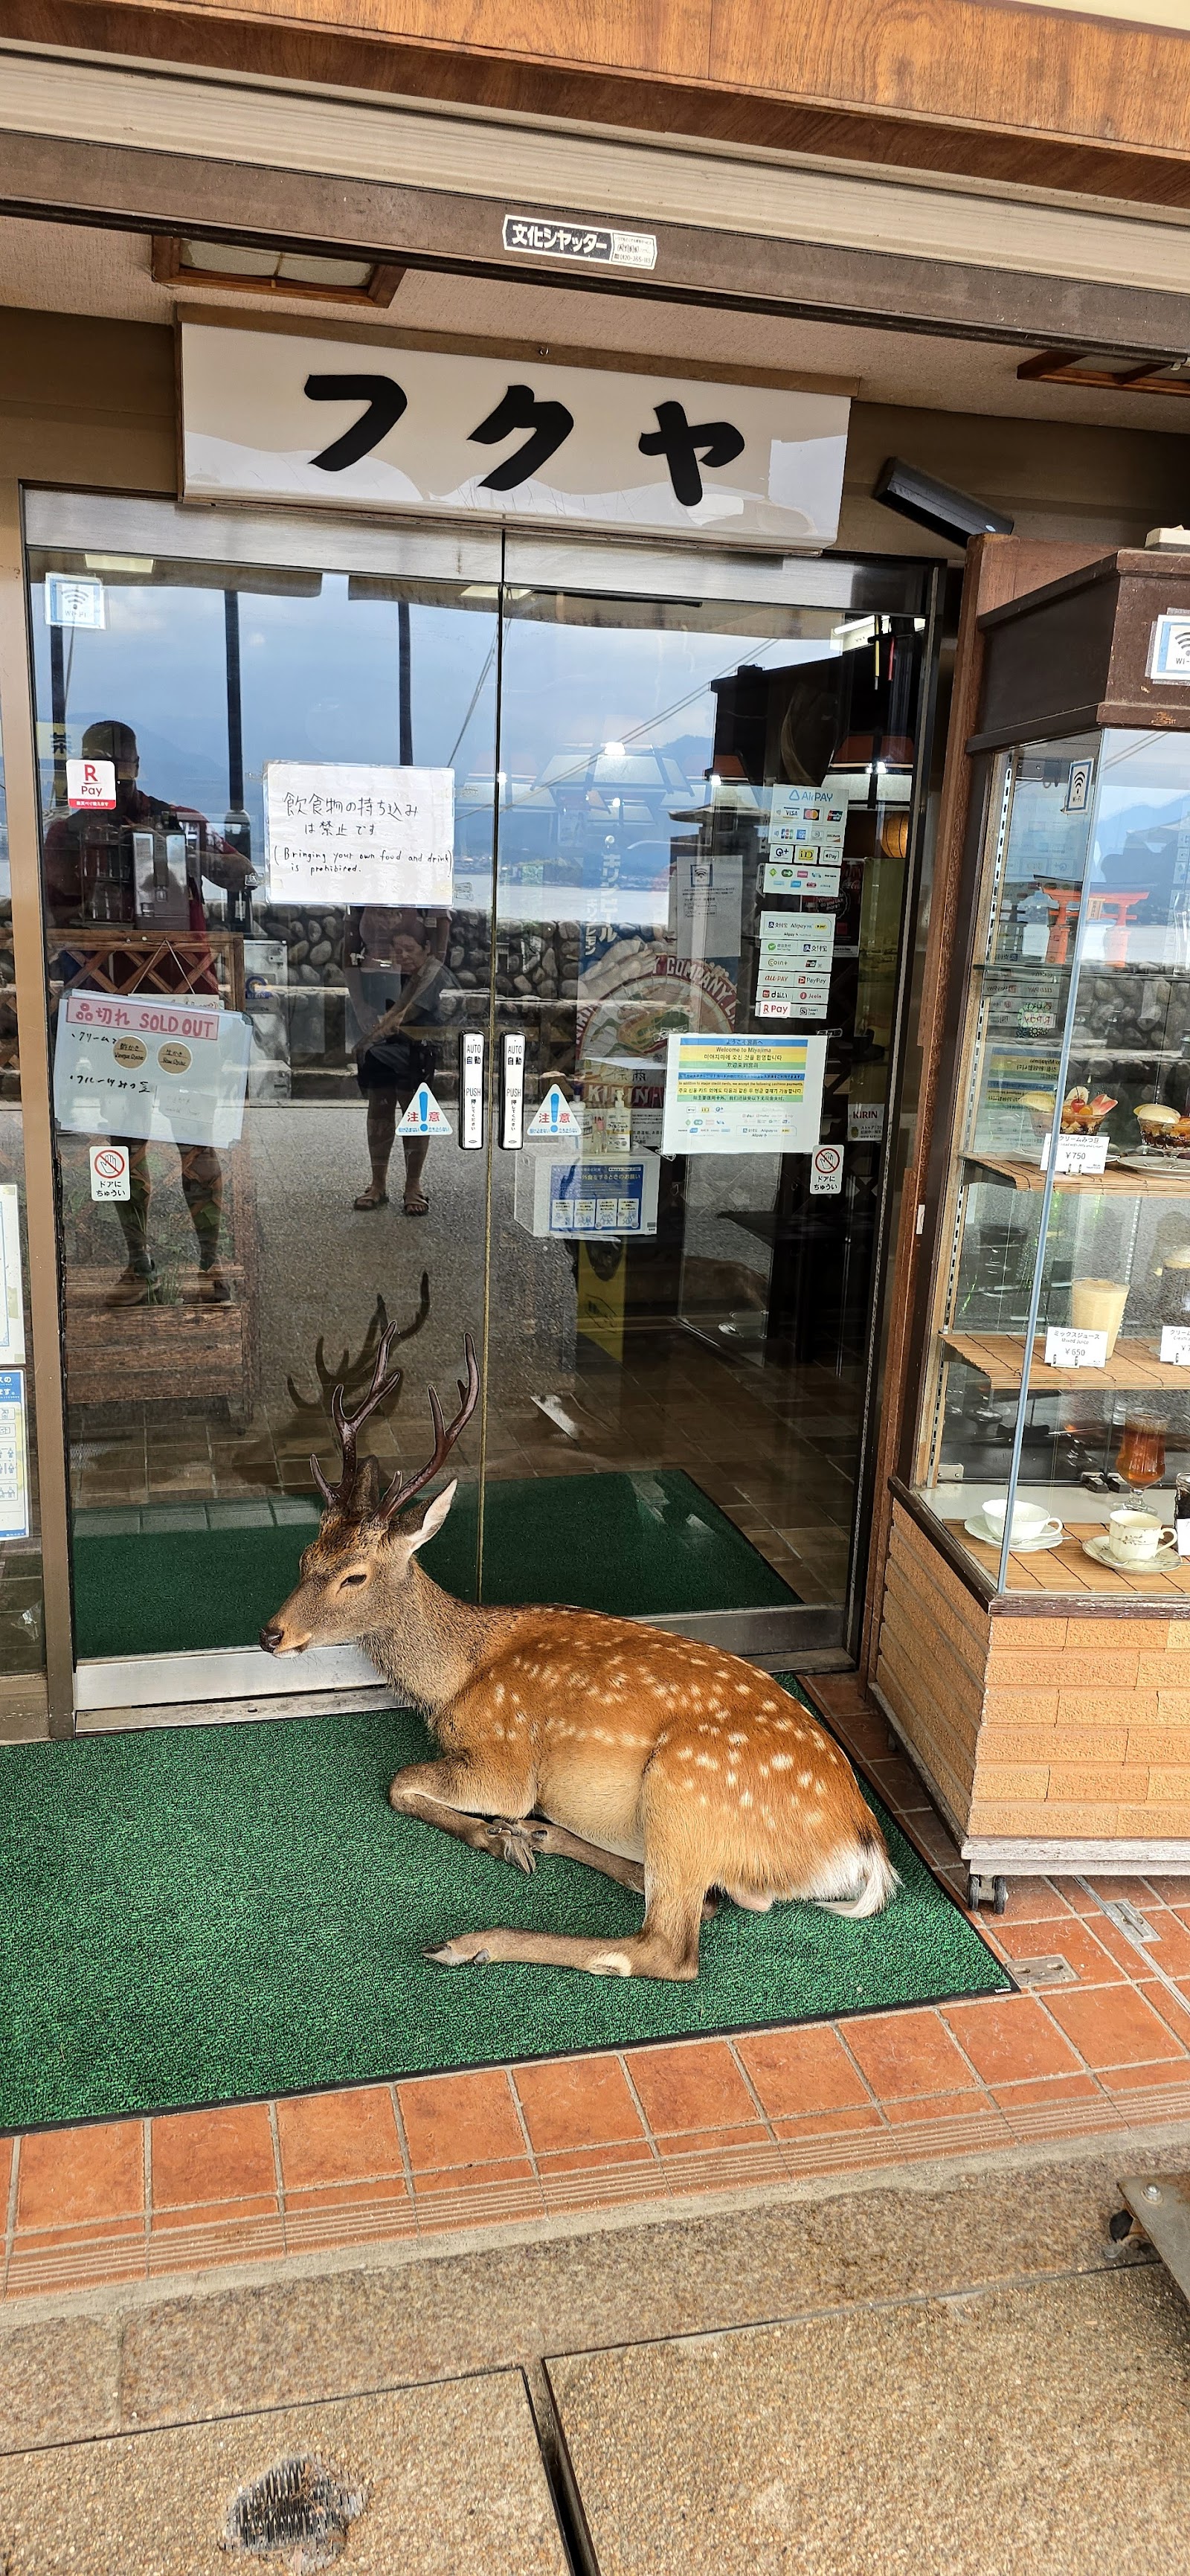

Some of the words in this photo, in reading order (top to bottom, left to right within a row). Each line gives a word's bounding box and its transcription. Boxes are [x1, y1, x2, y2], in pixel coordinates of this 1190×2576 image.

[303, 374, 745, 507] フクヤ
[83, 764, 98, 783] R
[81, 786, 103, 797] Pay
[801, 791, 833, 802] AirPAY
[283, 791, 418, 821] 飲食物の持ち込み
[304, 820, 376, 836] は禁止です
[334, 852, 353, 864] your
[379, 850, 402, 861] food
[408, 852, 422, 862] and
[806, 977, 826, 985] PayPay
[771, 1005, 788, 1014] Pay
[76, 1003, 130, 1026] 品切れ
[138, 1012, 179, 1032] SOLD
[181, 1018, 214, 1038] OUT
[466, 1044, 481, 1054] AUTO
[507, 1045, 522, 1054] AUTO
[466, 1056, 481, 1064] 自動
[507, 1056, 522, 1065] 自動
[466, 1088, 481, 1097] PUSH
[506, 1088, 521, 1097] PUSH
[852, 1111, 878, 1119] KIRIN
[1059, 1135, 1100, 1143] クリームみつ豆
[1053, 1329, 1100, 1340] ミックスジュース
